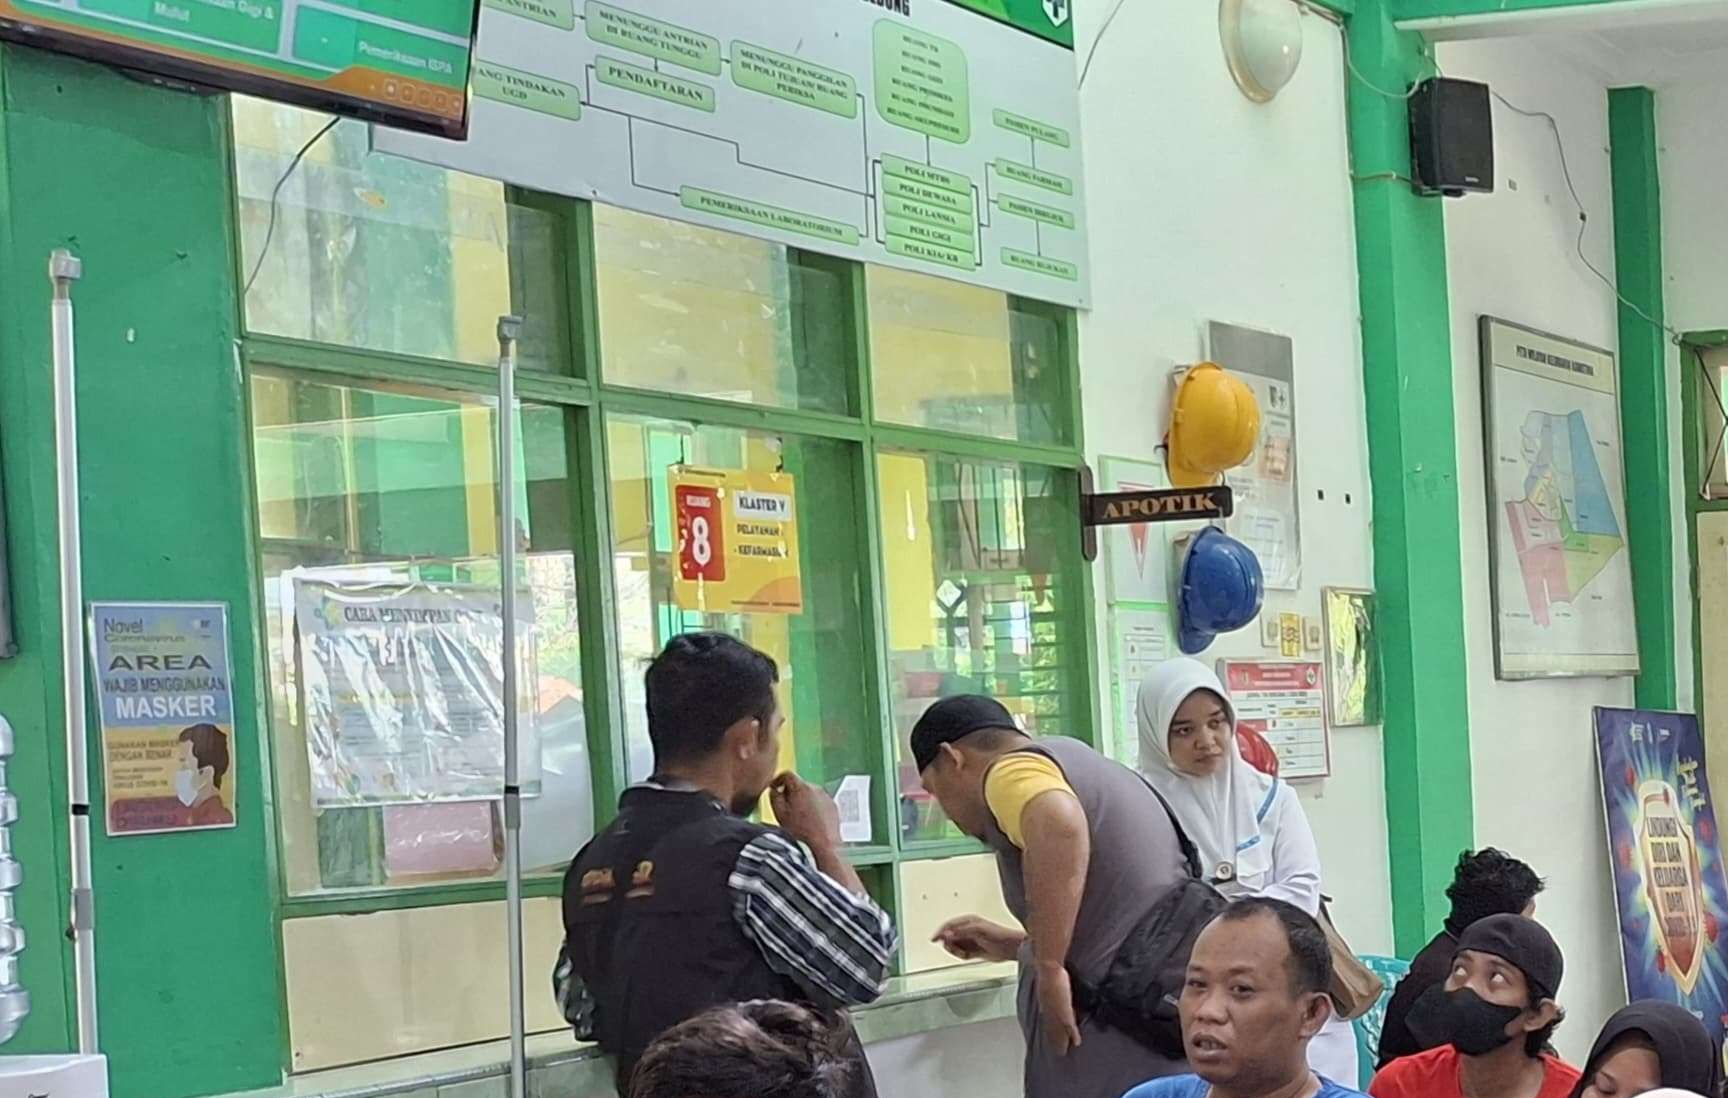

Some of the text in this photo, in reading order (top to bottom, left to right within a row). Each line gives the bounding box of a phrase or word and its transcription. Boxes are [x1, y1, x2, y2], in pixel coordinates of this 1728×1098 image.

[505, 74, 566, 98] TINDAKAN
[608, 66, 704, 101] PENDAFTARAN
[699, 195, 844, 237] PEMERIKSAAN LABORATORIUM
[738, 496, 777, 513] KLASTER
[1101, 492, 1220, 520] APOTIK
[691, 515, 712, 567] 8
[103, 617, 144, 634] Novel
[343, 606, 377, 623] CARA
[109, 654, 213, 671] AREA
[103, 676, 226, 693] WAJIB MENGGUNAKAN
[115, 694, 217, 720] MASKER
